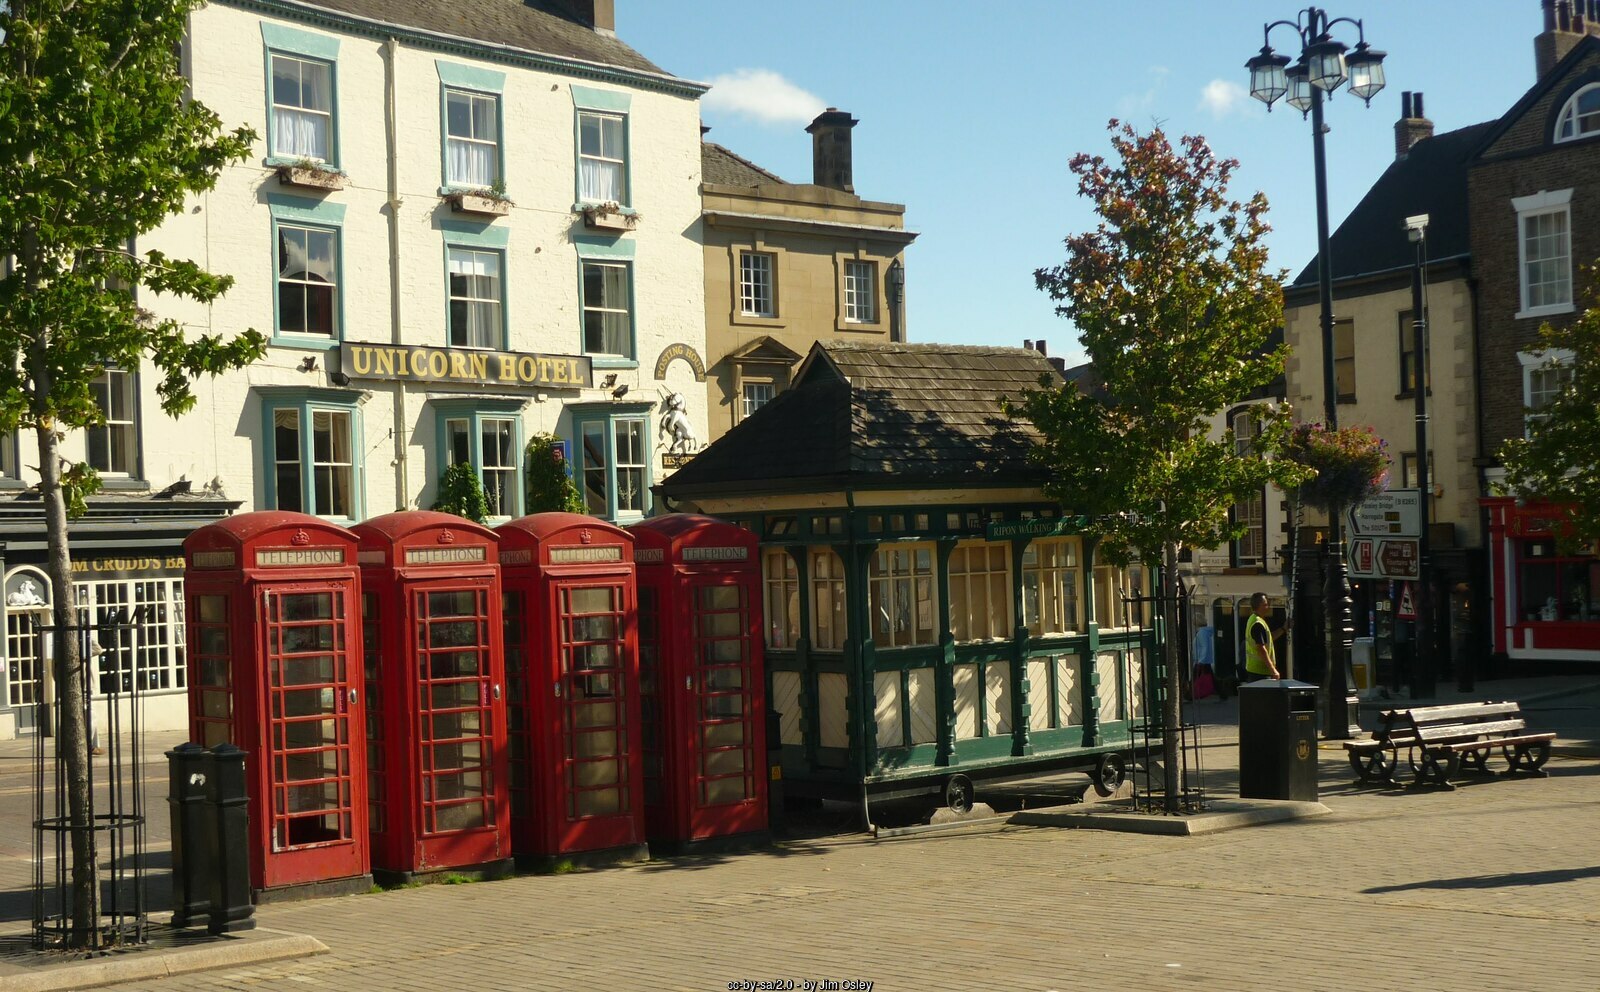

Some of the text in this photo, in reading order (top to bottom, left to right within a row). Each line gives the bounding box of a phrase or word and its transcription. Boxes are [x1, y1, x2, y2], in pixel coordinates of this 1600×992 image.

[350, 346, 584, 384] UNICORN HOTEL
[657, 346, 705, 381] POSTING HOUSE
[993, 526, 1017, 538] RIPON
[1019, 523, 1052, 534] WALKING
[262, 551, 341, 564] TELEPHONE
[410, 549, 482, 562] TELEPHONE
[554, 549, 620, 562] TELEPHONE
[685, 549, 745, 560] TELEPHONE
[92, 555, 162, 572] CRUDD'S
